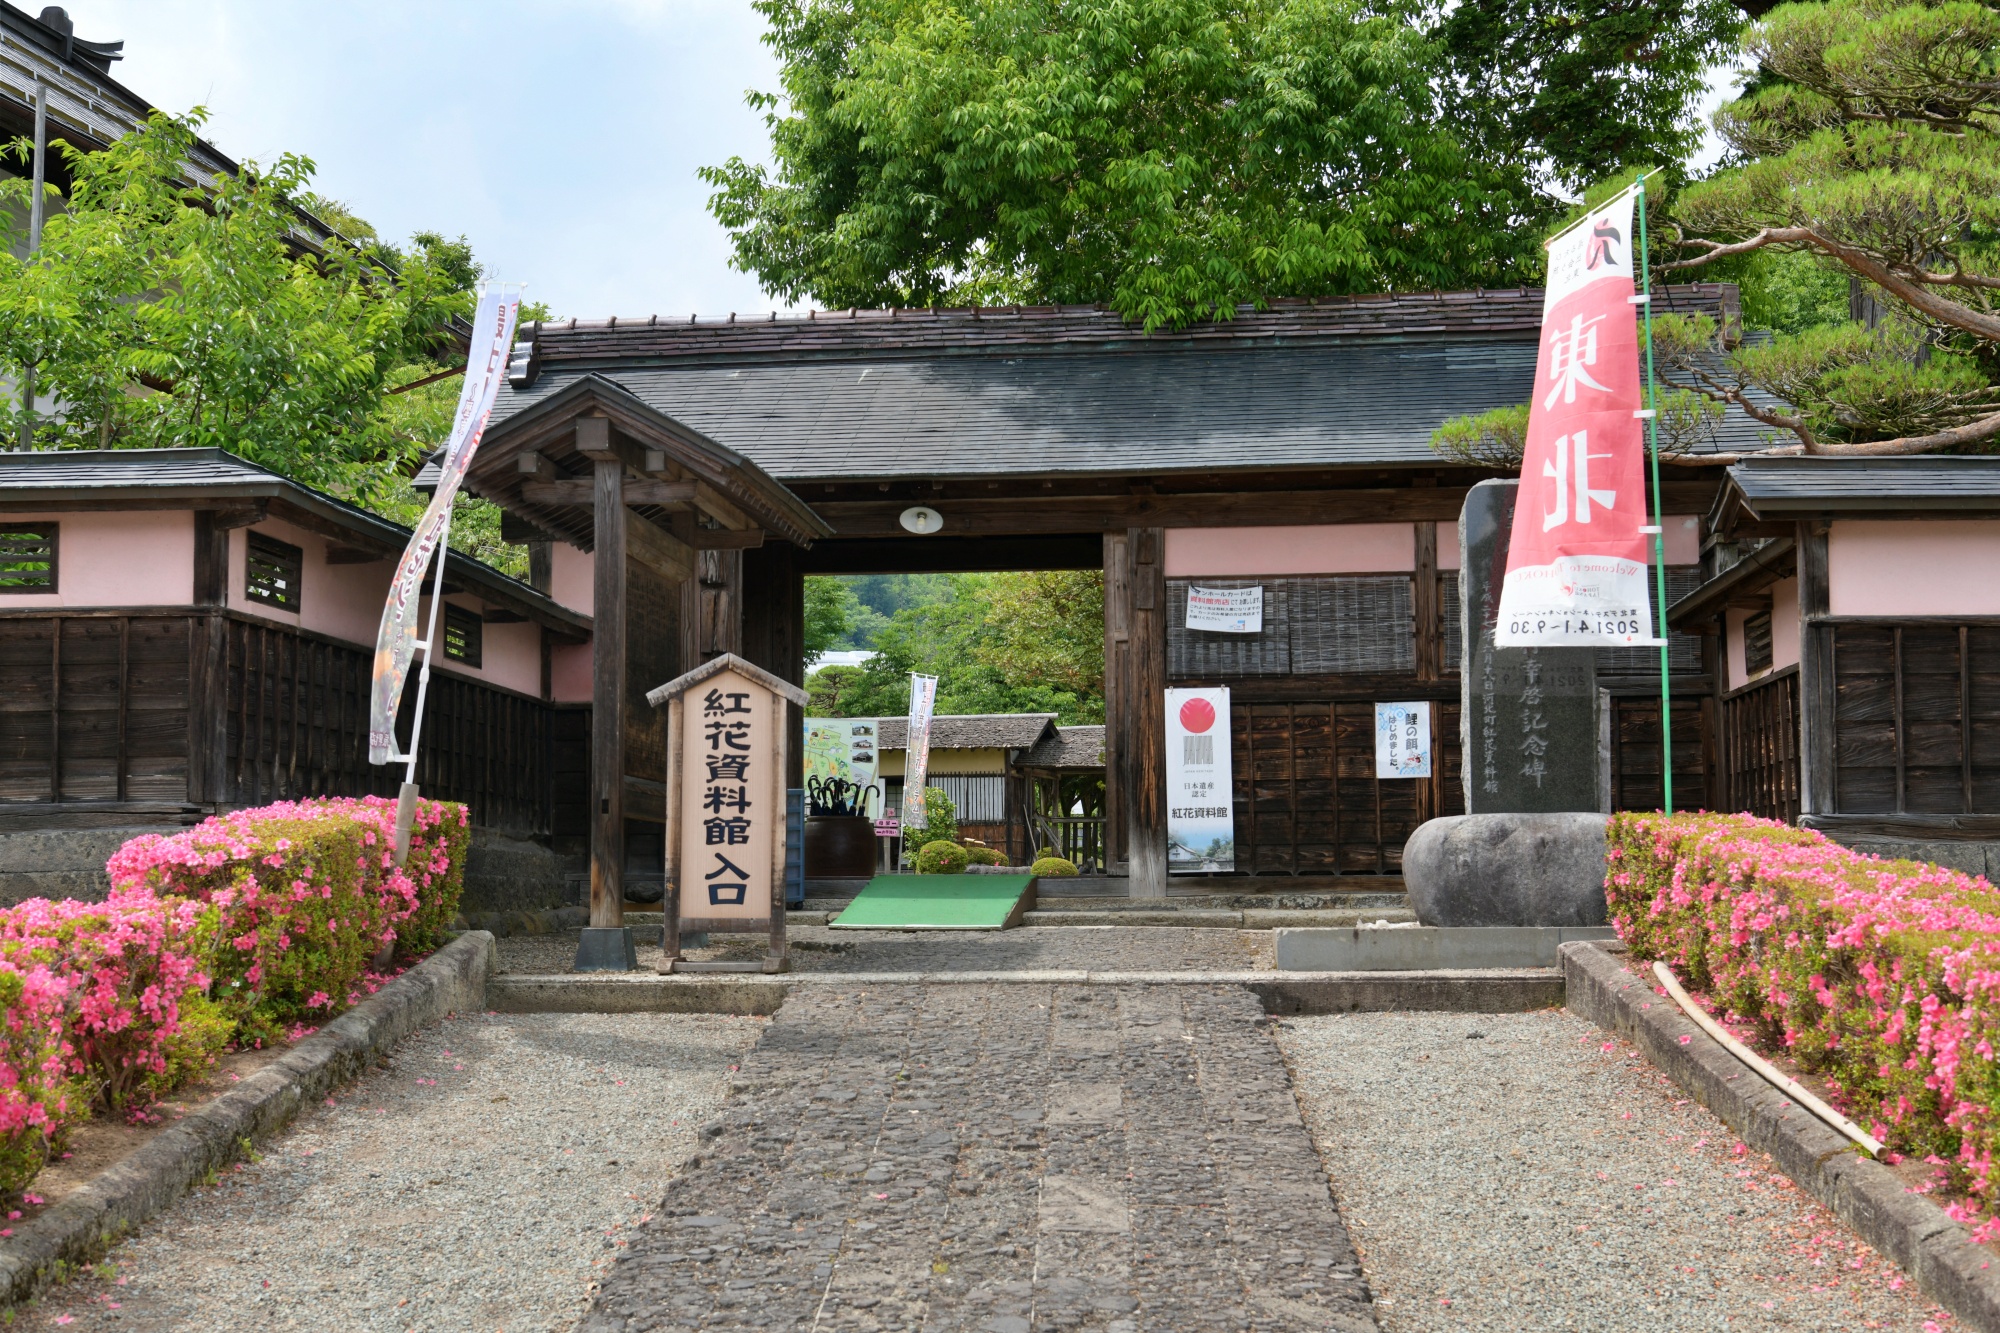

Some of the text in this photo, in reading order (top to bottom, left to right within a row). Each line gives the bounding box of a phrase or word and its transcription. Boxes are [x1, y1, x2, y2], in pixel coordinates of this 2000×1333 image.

[1405, 712, 1419, 751] 鯉の餌
[1388, 715, 1400, 771] はじめました。
[1184, 782, 1215, 790] 日本遺産
[1191, 790, 1207, 798] 認定
[1171, 806, 1228, 819] 紅花資料館
